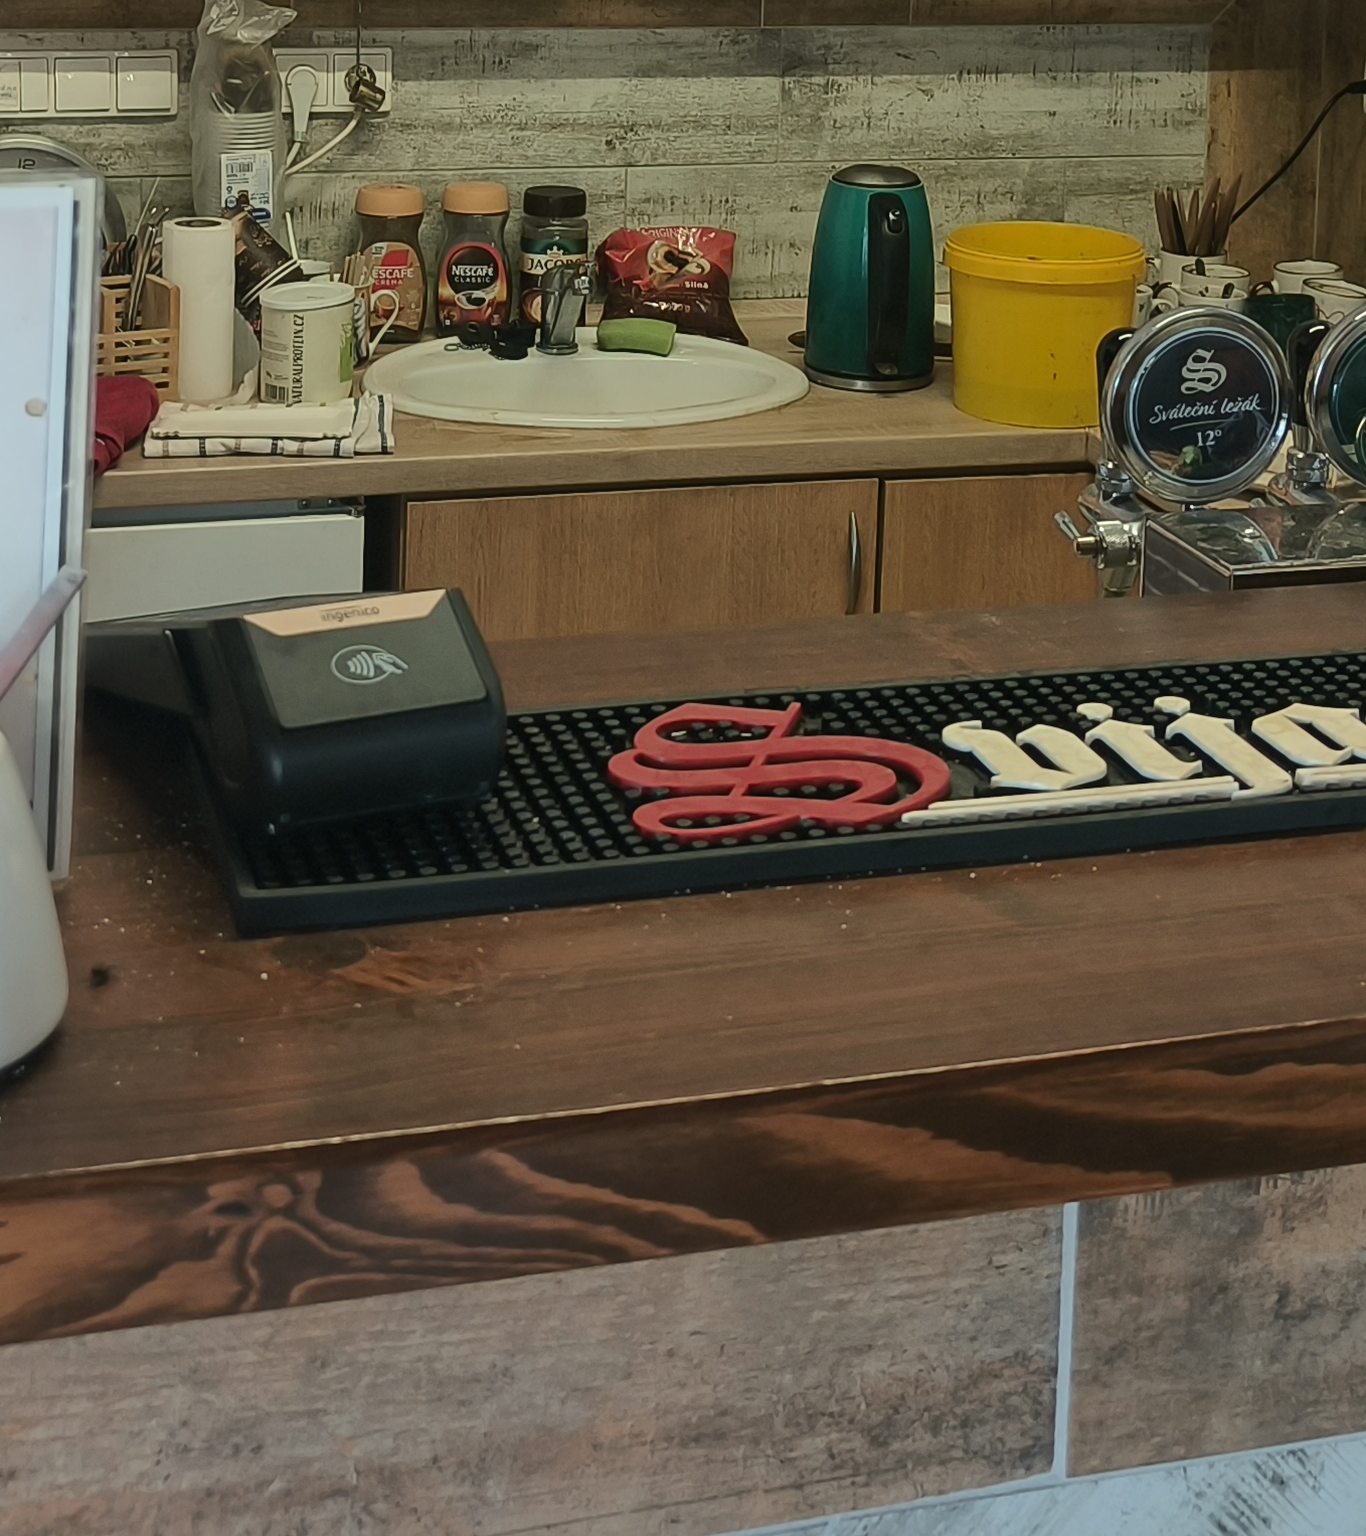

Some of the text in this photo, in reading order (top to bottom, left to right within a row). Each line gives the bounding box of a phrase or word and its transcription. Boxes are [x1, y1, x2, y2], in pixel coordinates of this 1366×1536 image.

[17, 157, 36, 170] 12
[451, 264, 495, 278] NESCAFÉ
[454, 276, 492, 284] CLASSIC
[1220, 393, 1263, 414] ležák
